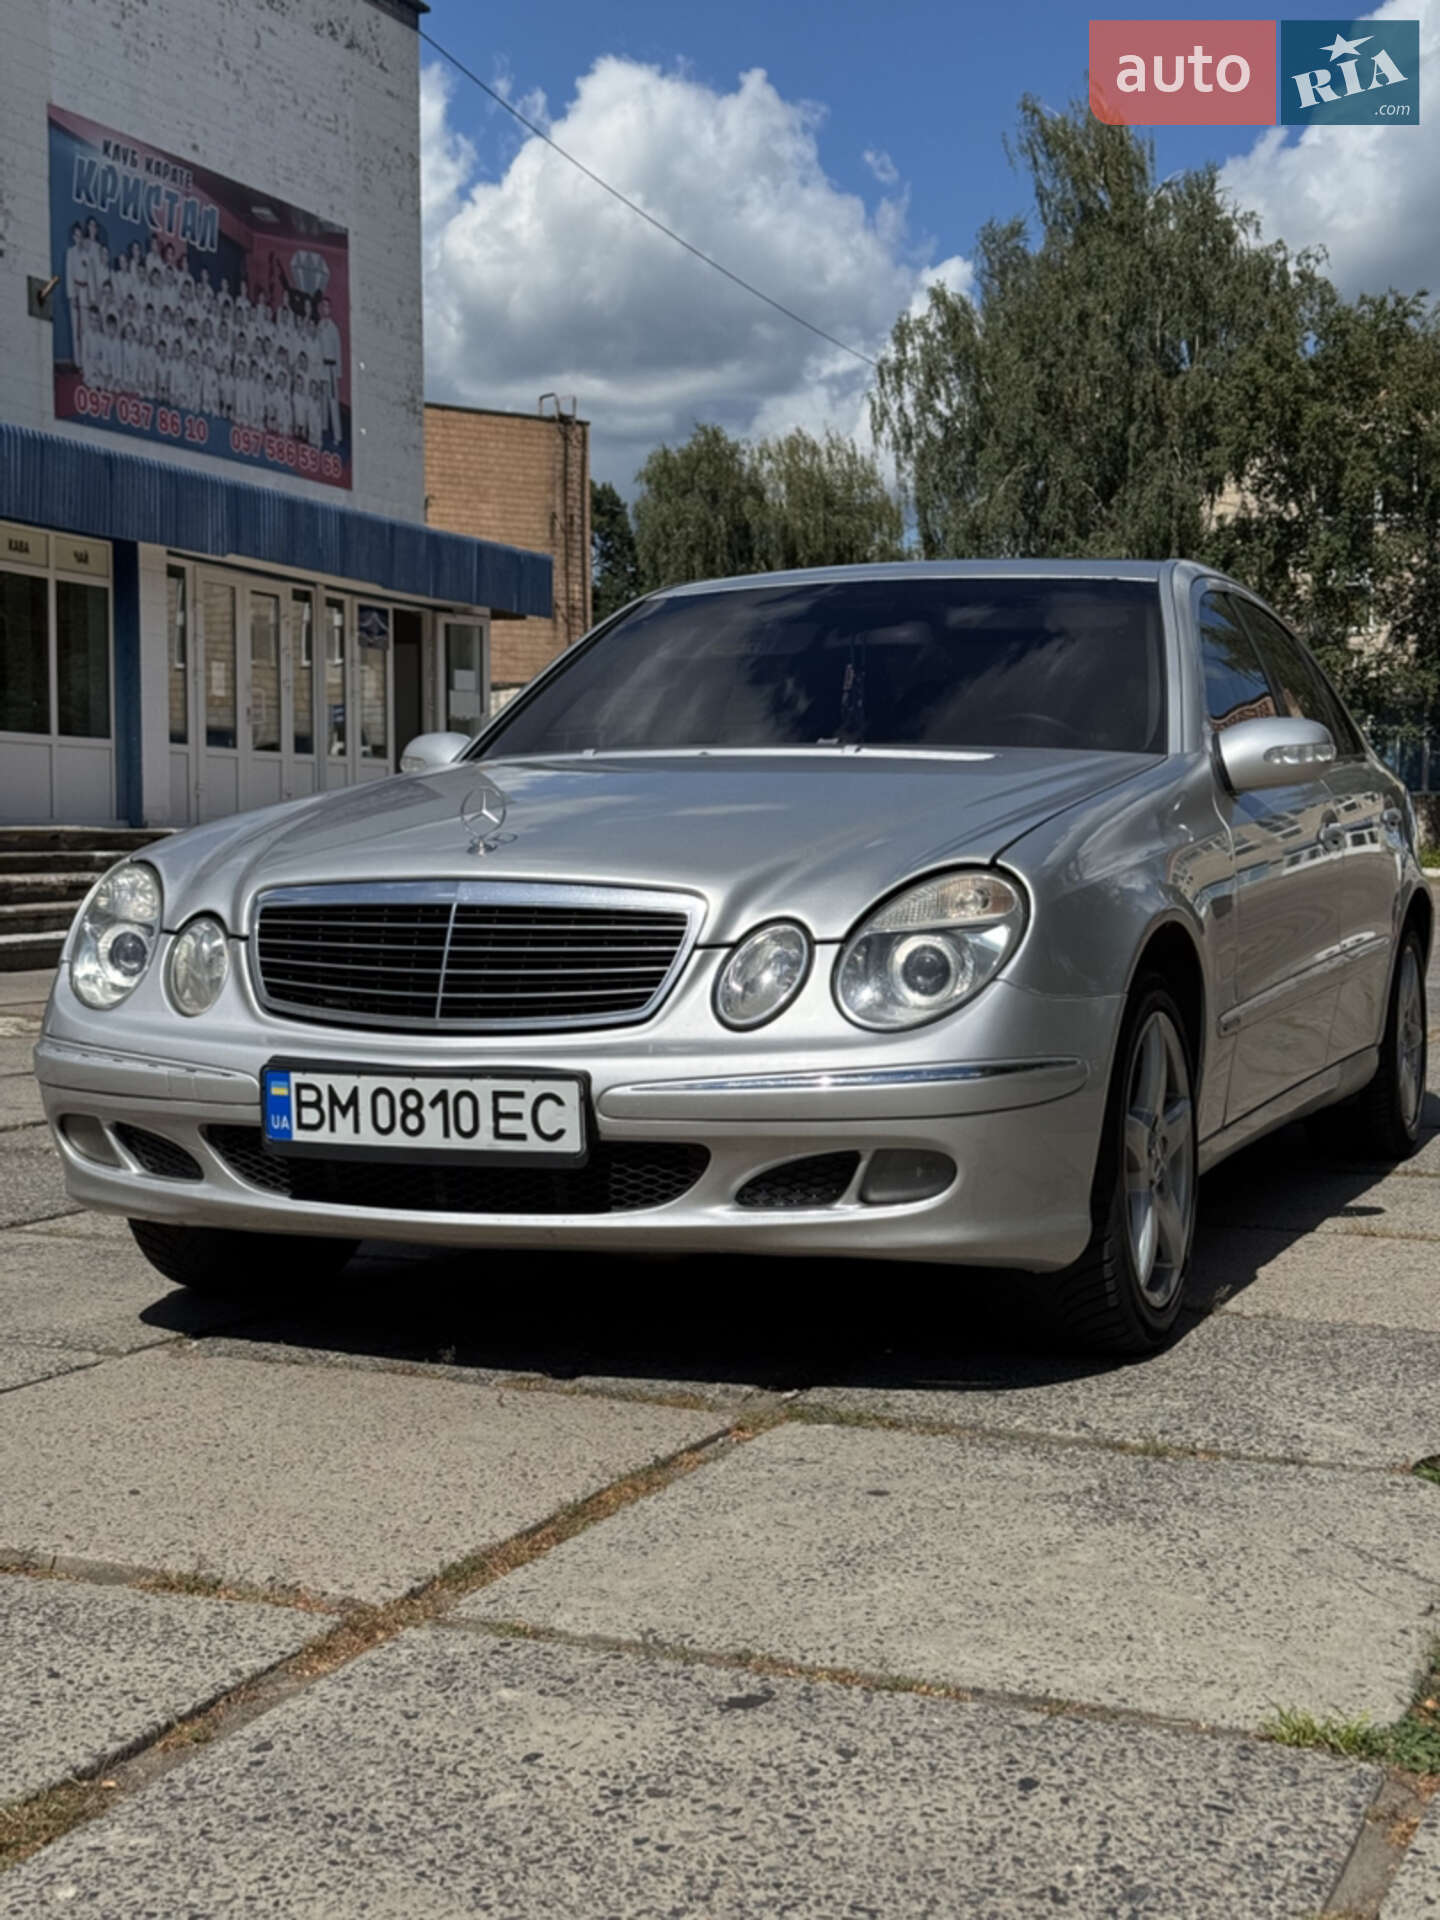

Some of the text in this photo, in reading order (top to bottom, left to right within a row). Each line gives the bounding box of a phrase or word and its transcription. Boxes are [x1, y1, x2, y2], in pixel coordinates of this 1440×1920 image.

[102, 139, 193, 188] КЛУБ КАРАТЕ
[72, 154, 220, 252] КРИСТАЛ
[75, 385, 208, 444] 097 037 86 10
[271, 1115, 290, 1130] UA
[295, 1082, 567, 1143] BM 0810 EC
